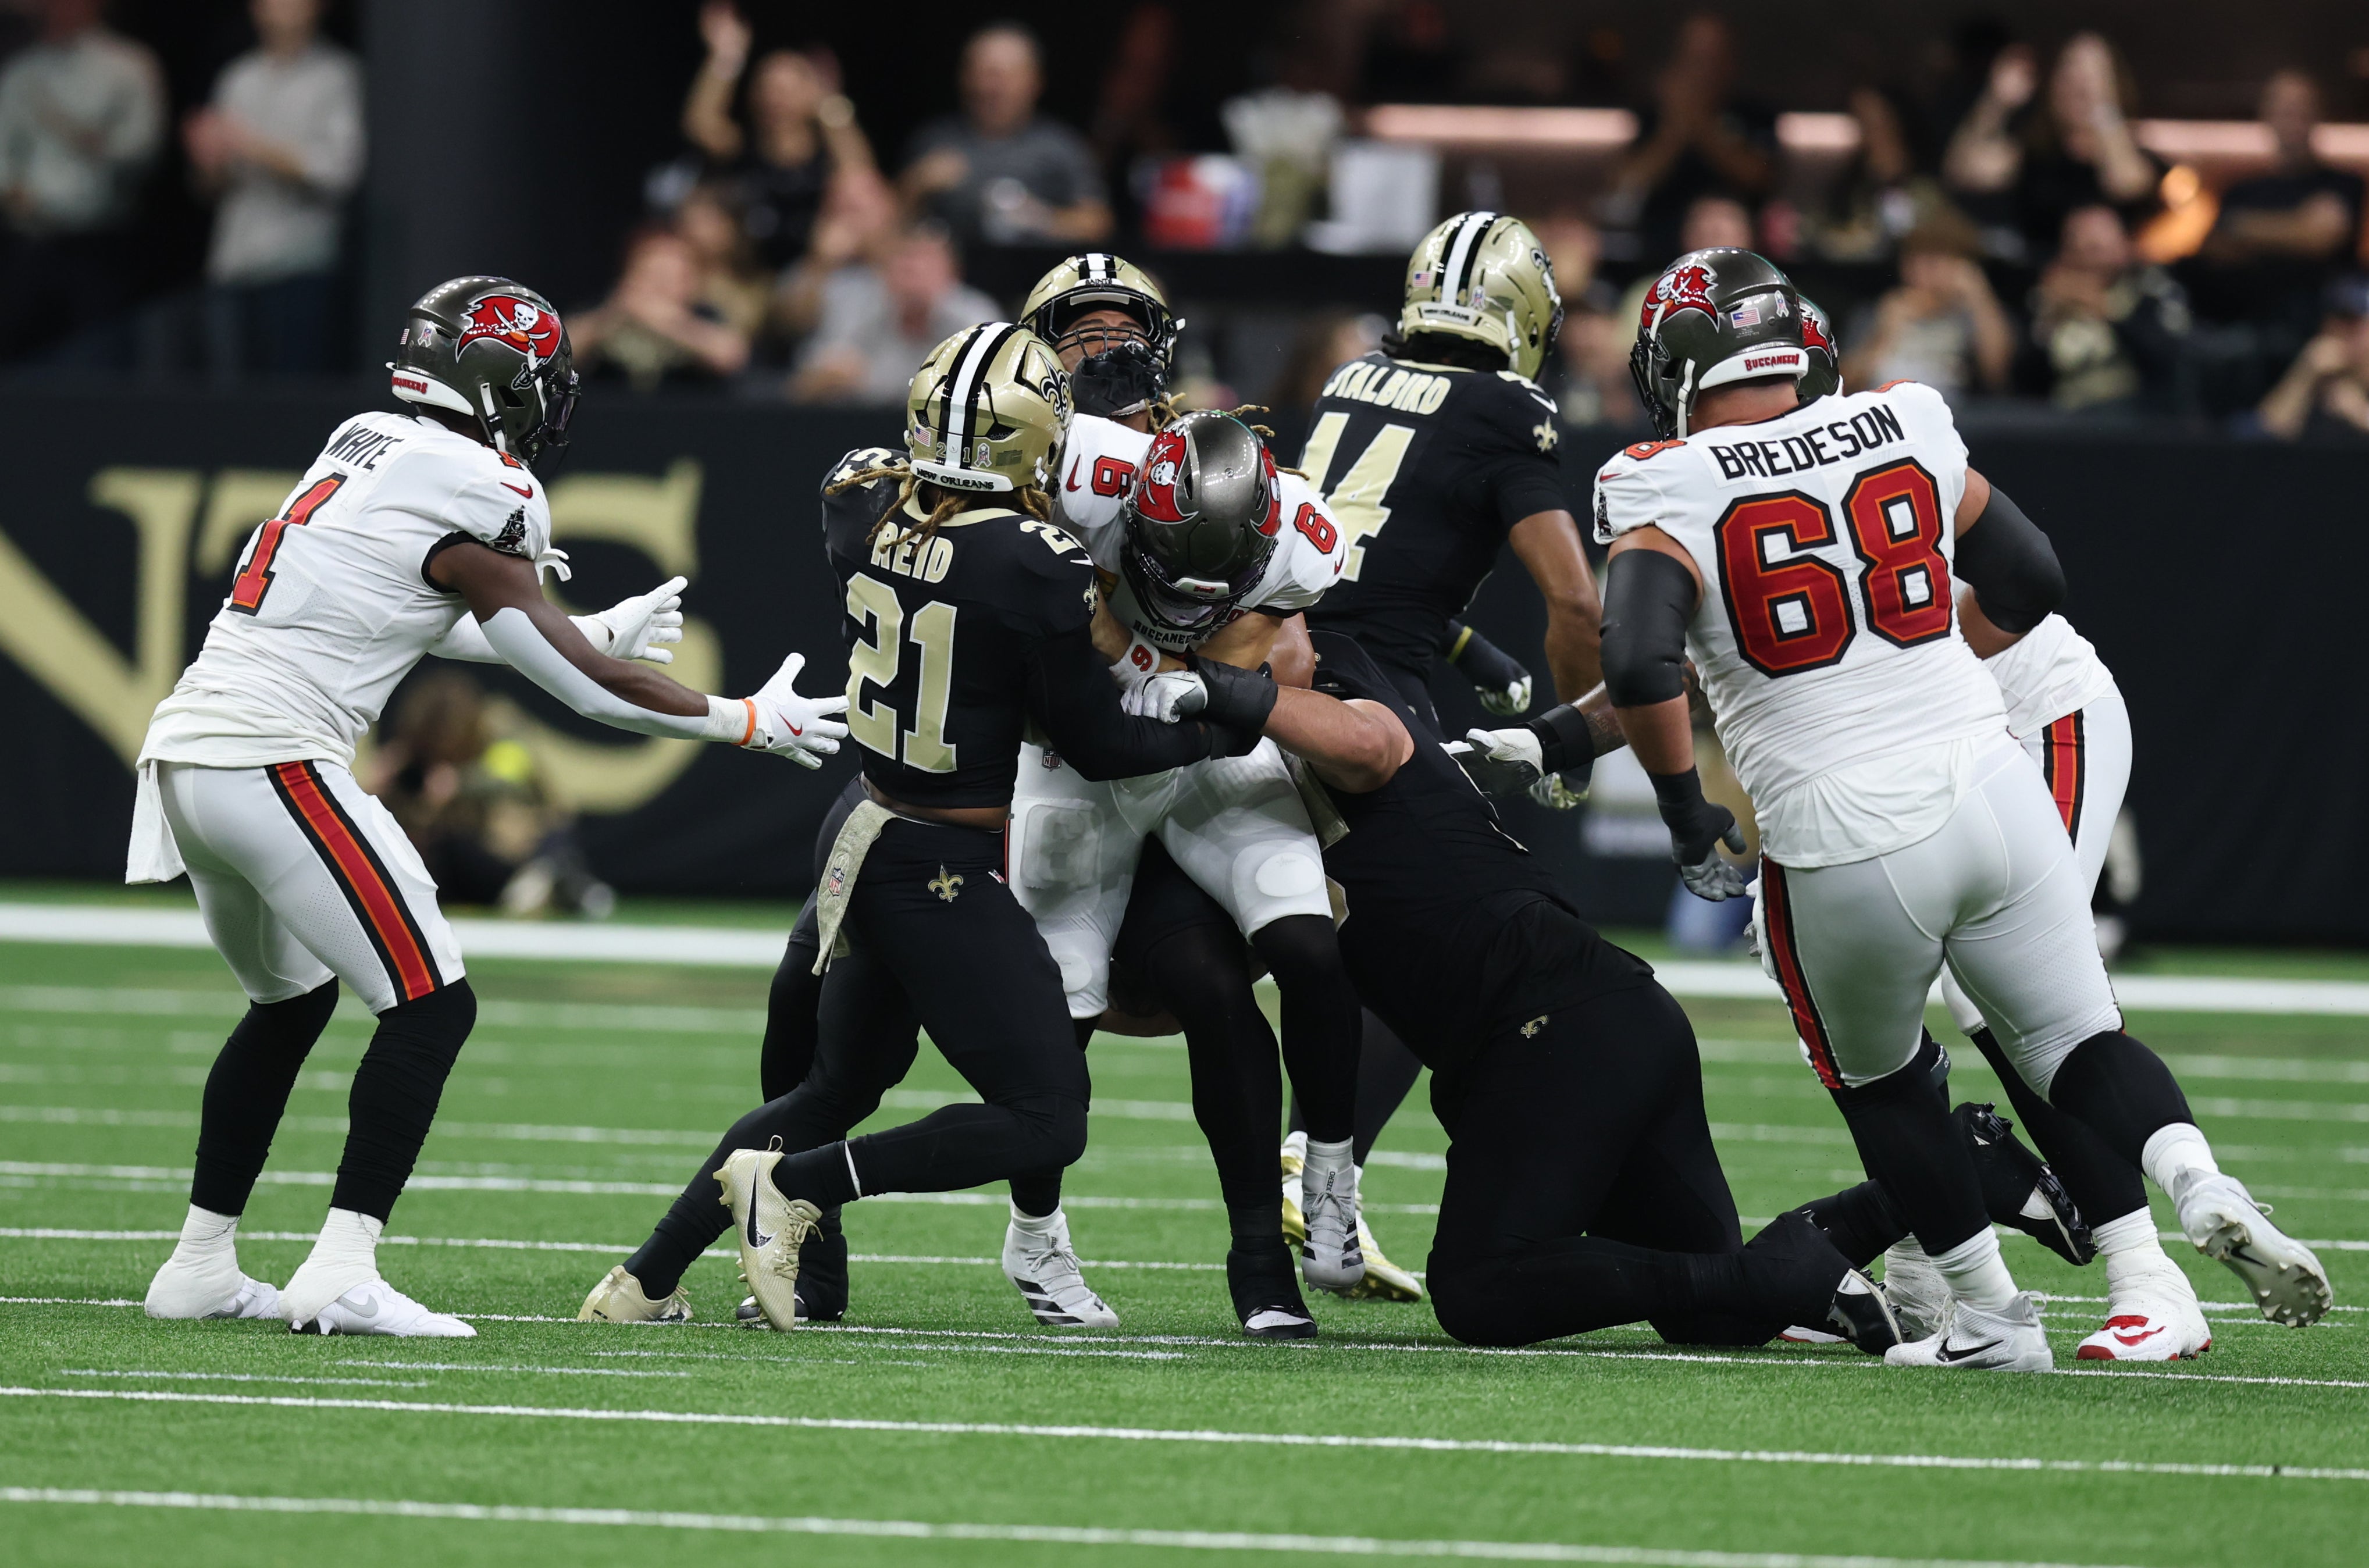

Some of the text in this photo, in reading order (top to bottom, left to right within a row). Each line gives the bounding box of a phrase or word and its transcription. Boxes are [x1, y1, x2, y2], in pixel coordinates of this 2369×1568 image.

[325, 422, 405, 471] WHITE
[1709, 405, 1904, 479] BREDESON
[916, 468, 995, 490] NEW ORLEANS
[227, 472, 348, 616] 1
[870, 521, 954, 583] REID
[1294, 502, 1337, 555] 6
[1713, 457, 1952, 678] 68
[0, 459, 724, 813] NS
[1134, 619, 1209, 644] BUCCANEE
[845, 571, 957, 774] 21
